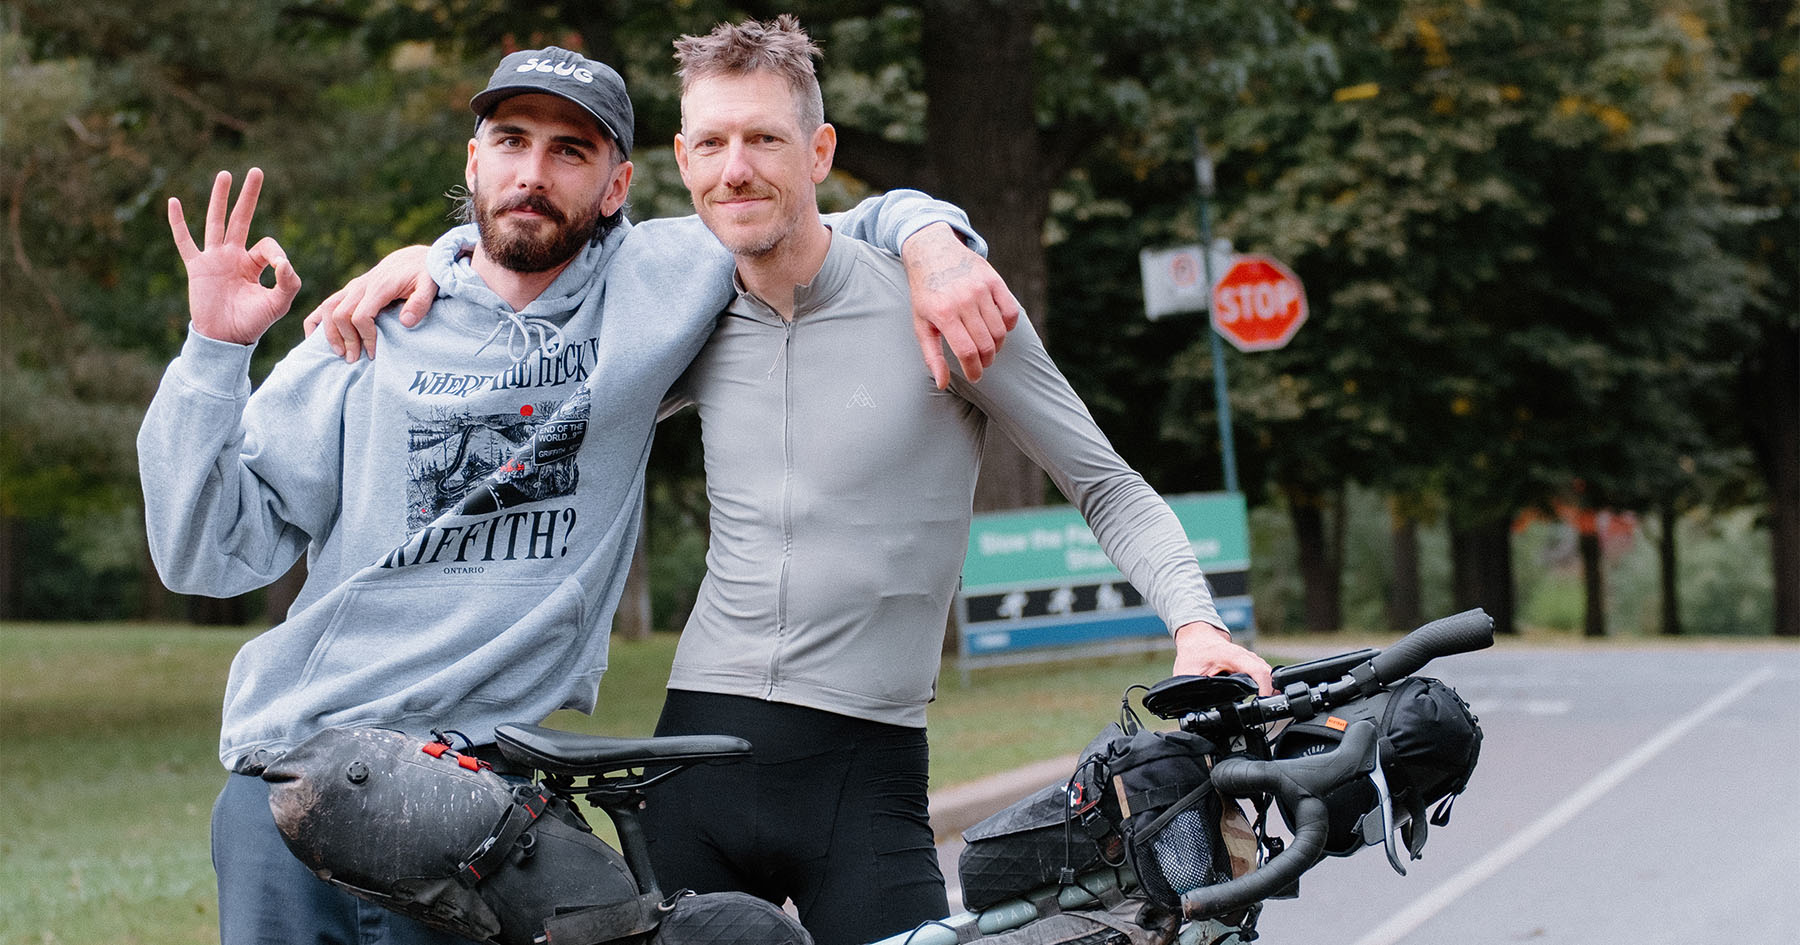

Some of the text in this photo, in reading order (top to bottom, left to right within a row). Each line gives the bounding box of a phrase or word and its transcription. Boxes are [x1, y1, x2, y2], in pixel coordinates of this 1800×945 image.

[516, 58, 594, 84] SLUG
[1218, 279, 1299, 324] STOP
[534, 339, 589, 388] HECK
[539, 422, 585, 435] END OF THE
[443, 566, 485, 575] ONTARIO
